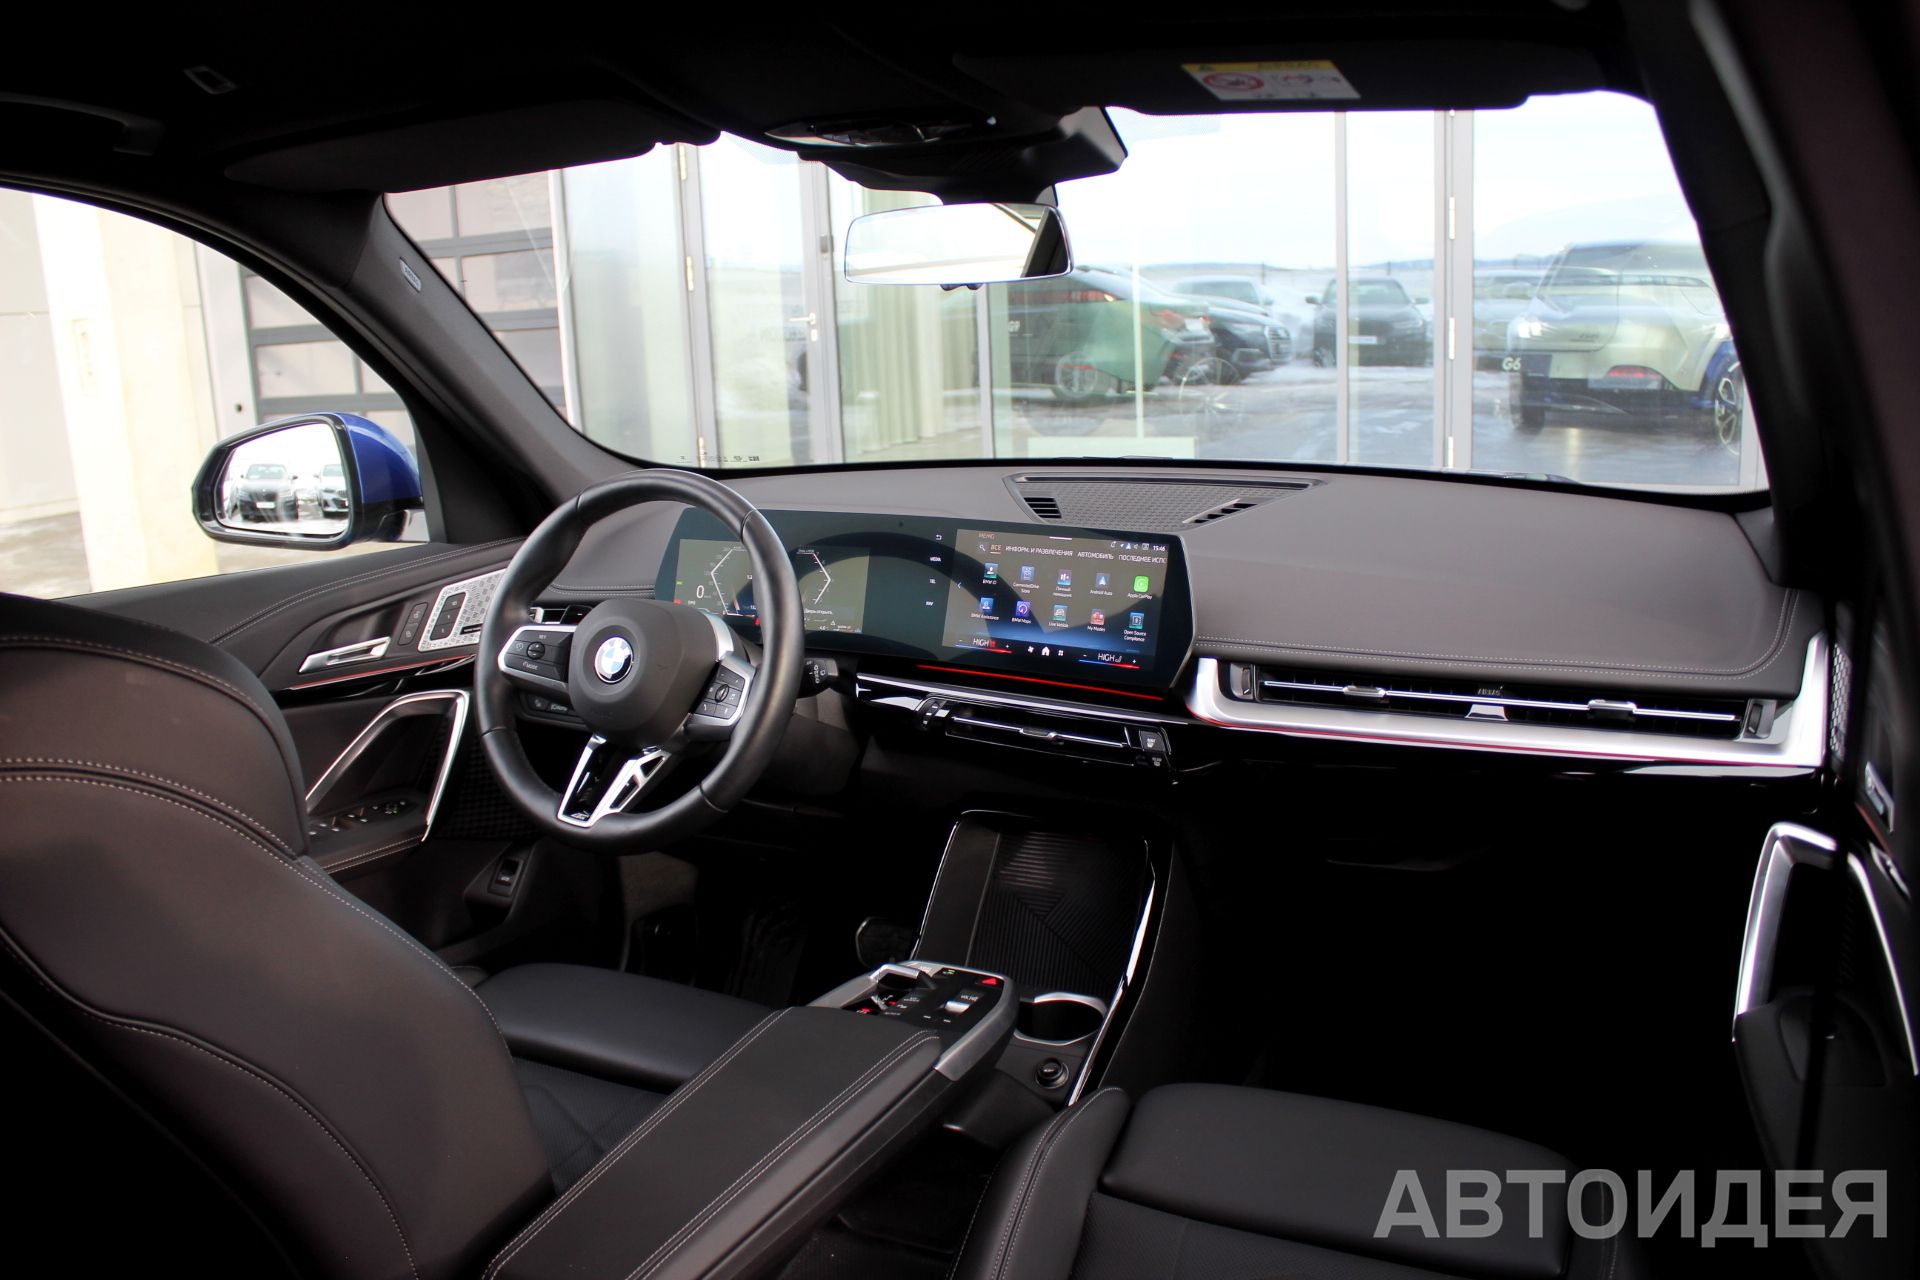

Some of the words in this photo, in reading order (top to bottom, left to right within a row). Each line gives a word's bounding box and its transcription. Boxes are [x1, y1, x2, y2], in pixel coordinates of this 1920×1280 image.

[1502, 356, 1521, 370] G6
[1036, 548, 1073, 556] РАЗВЛЕЧЕНИЯ
[1078, 552, 1114, 560] АВТОМОБИЛЬ
[1118, 554, 1151, 563] ПОСЛЕДНЕЕ
[696, 584, 704, 598] 0
[972, 638, 989, 646] HIGH
[1098, 653, 1115, 661] HIGH
